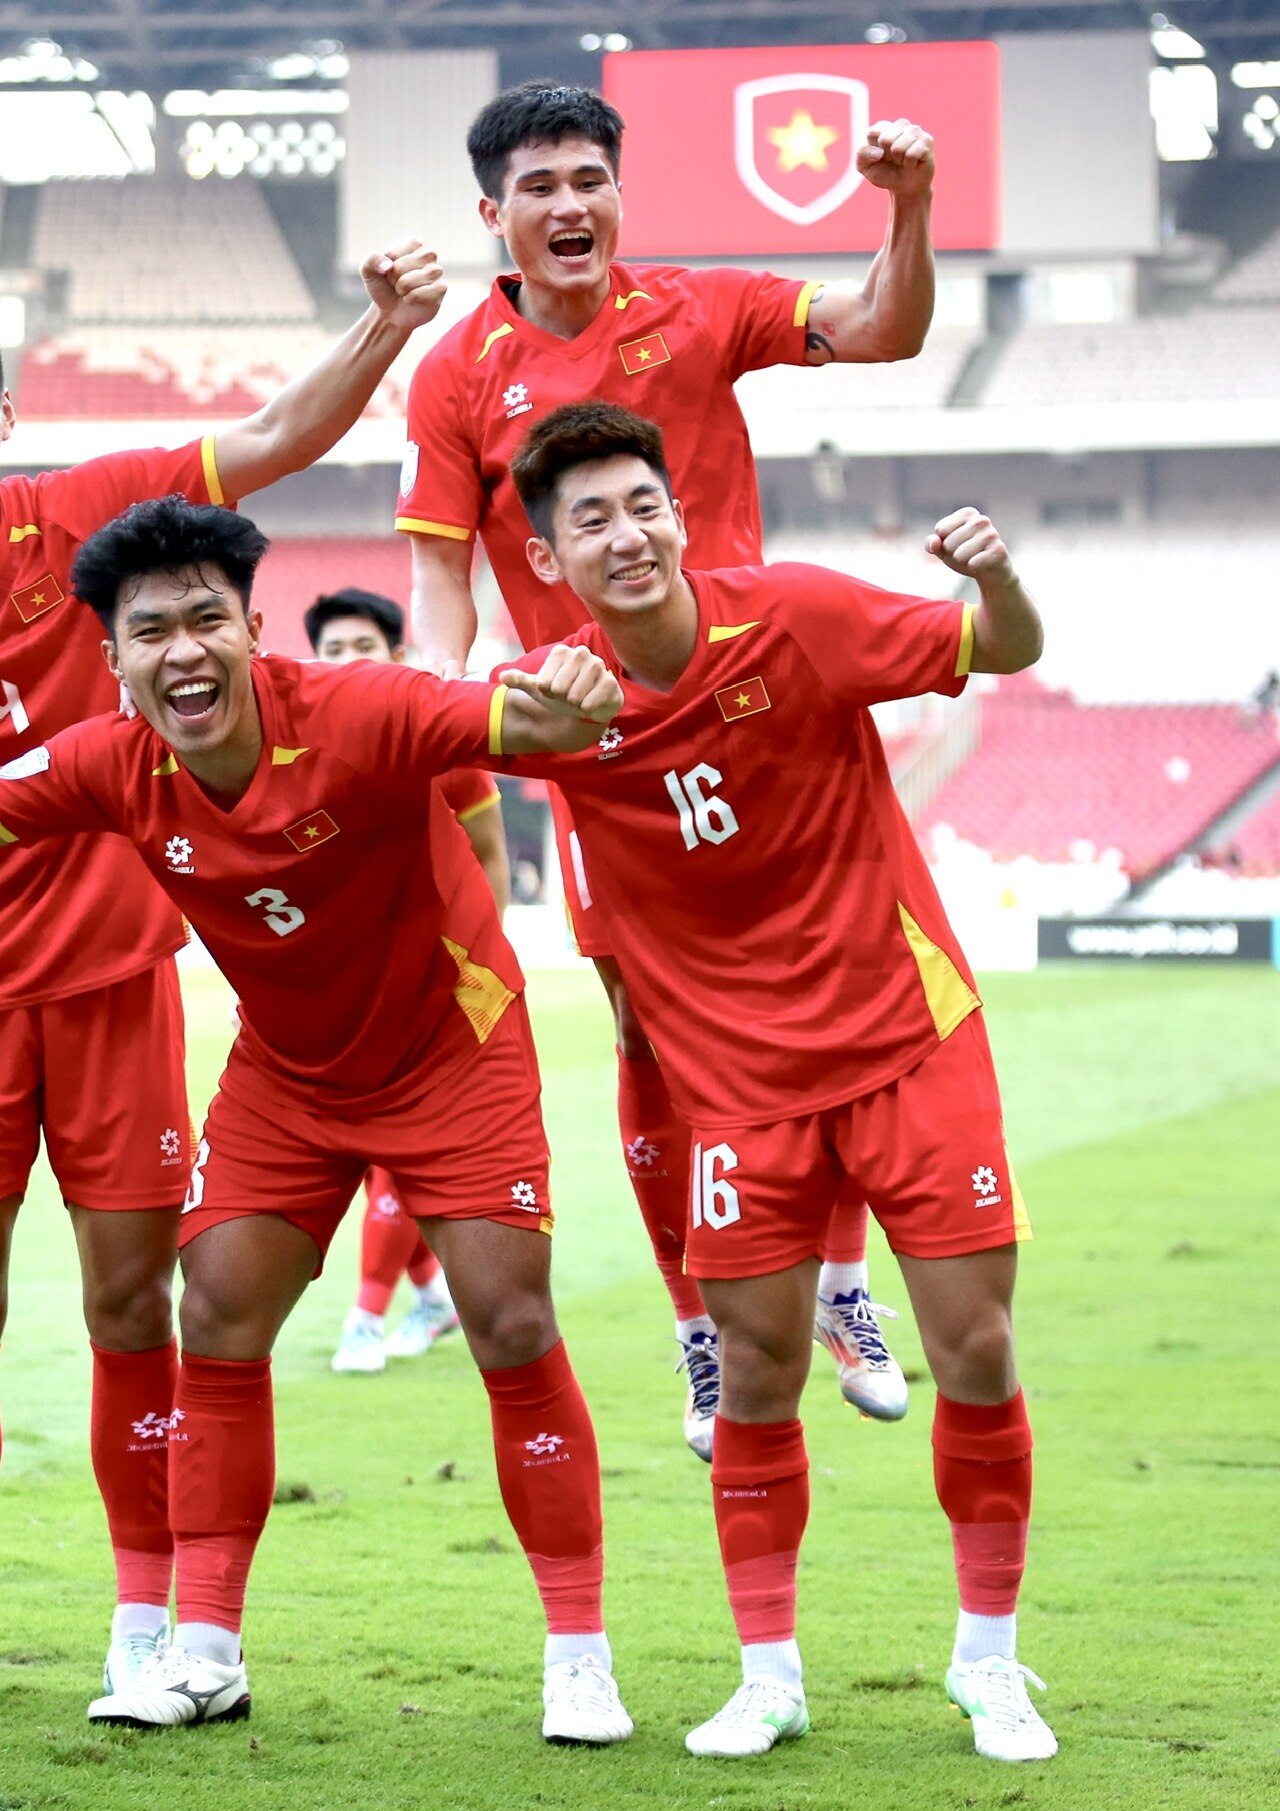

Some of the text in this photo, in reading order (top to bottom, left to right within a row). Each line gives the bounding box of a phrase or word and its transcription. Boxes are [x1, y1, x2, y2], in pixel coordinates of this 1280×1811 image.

[663, 761, 740, 851] 16
[243, 887, 306, 938] 3
[692, 1141, 742, 1231] 16
